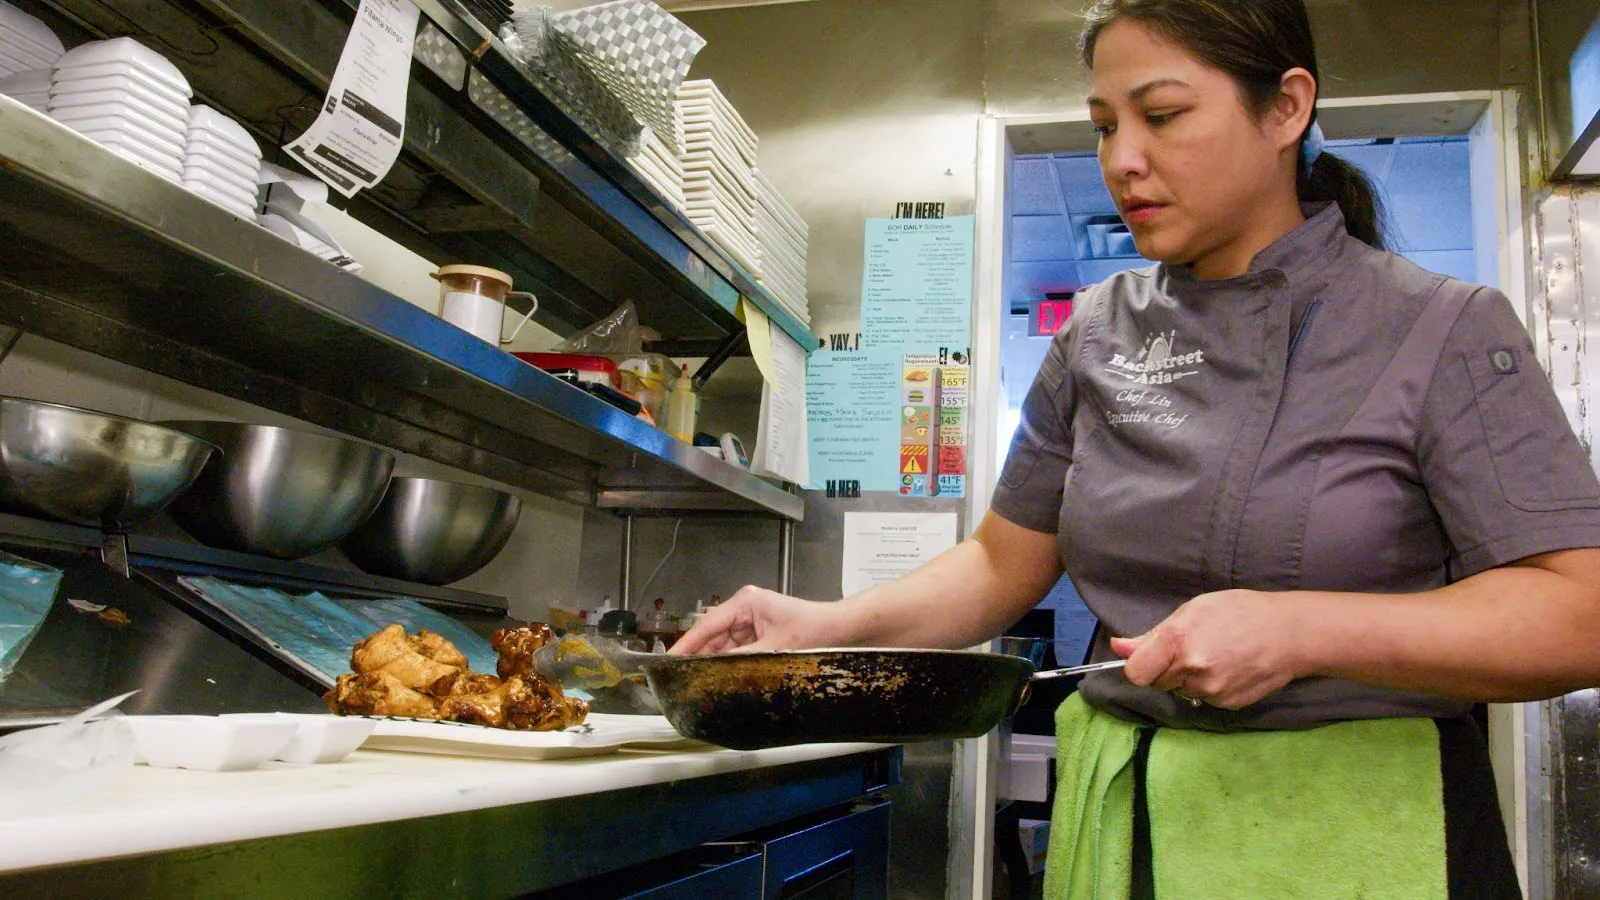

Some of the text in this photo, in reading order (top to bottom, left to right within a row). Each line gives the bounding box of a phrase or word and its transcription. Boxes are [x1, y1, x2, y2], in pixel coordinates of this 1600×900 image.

[895, 202, 945, 219] I'M HERE!
[830, 333, 853, 352] YAY,
[1107, 349, 1204, 373] Backstreet
[941, 377, 967, 386] 165°F
[1132, 371, 1172, 385] Asia
[941, 396, 967, 405] 155°F
[1116, 389, 1172, 408] Chef Lin
[1106, 409, 1189, 429] Executive Chef
[838, 479, 861, 498] HER
[940, 475, 961, 484] 41°F
